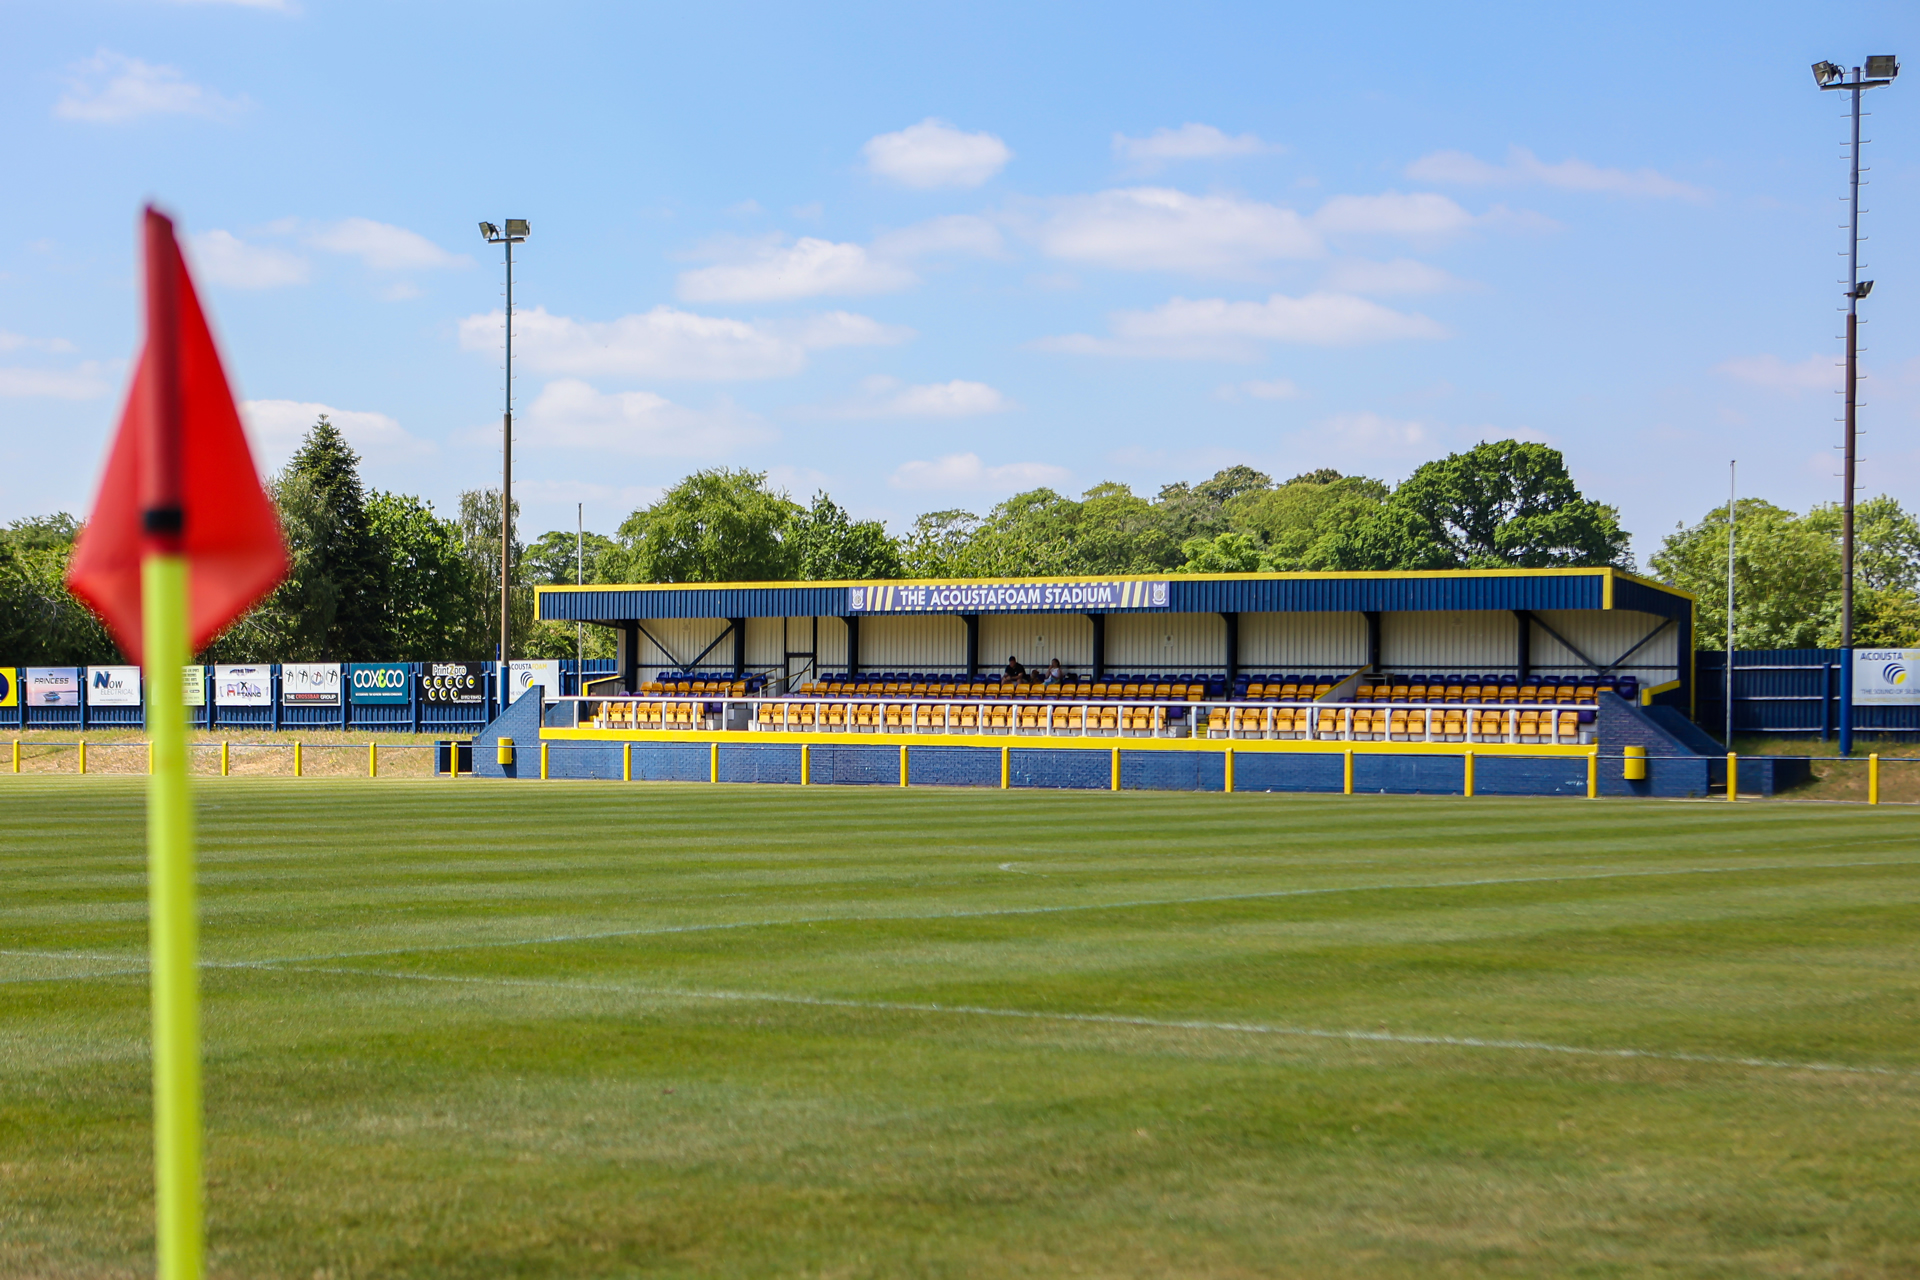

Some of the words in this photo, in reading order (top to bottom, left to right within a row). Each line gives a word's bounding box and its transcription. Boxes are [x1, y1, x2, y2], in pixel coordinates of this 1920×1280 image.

[900, 590, 926, 606] THE
[930, 588, 1041, 606] ACOUSTAFOAM
[1044, 587, 1112, 603] STADIUM
[34, 677, 70, 685] PRINCESS
[100, 688, 135, 696] ELECTRICAL
